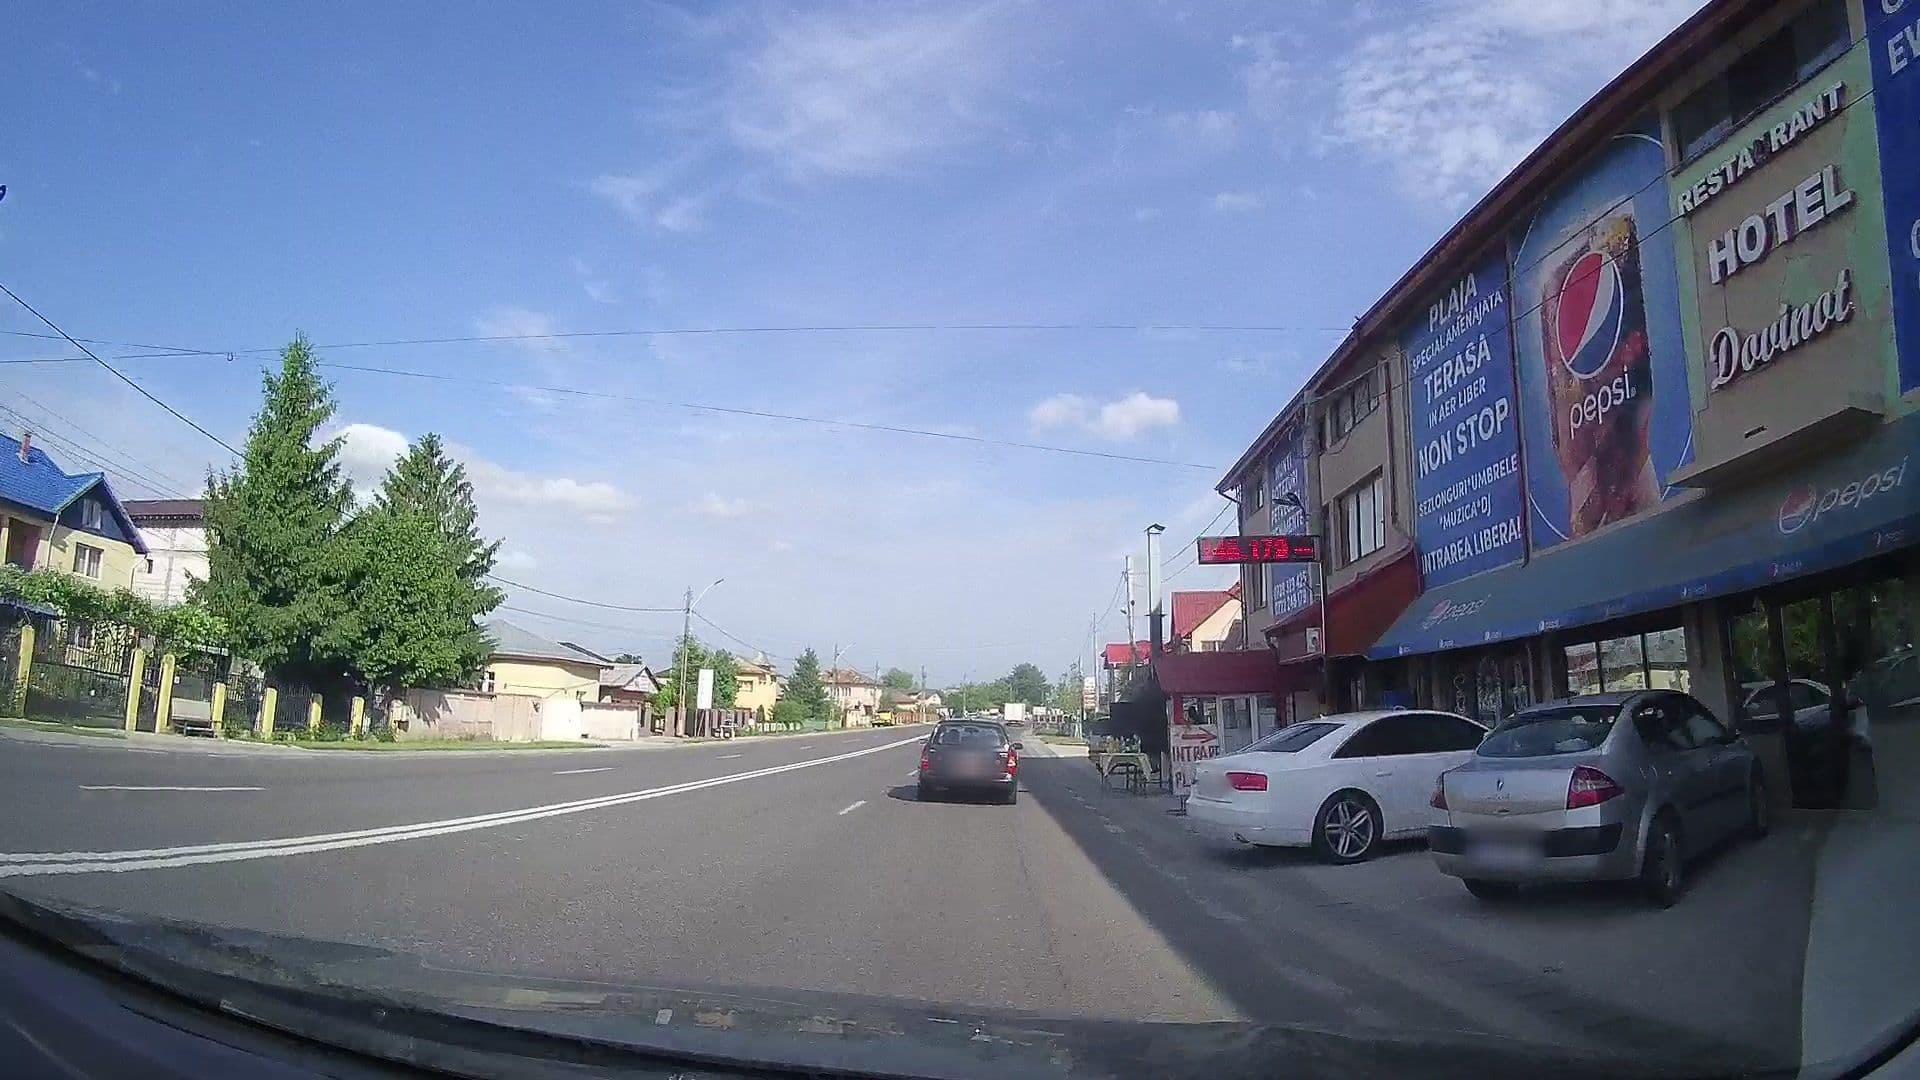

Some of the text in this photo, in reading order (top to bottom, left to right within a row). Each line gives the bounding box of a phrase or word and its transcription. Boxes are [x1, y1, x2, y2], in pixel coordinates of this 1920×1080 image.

[1709, 164, 1853, 285] HOTEL
[1429, 272, 1478, 333] PLAJA
[1458, 375, 1486, 409] LIBER
[1570, 364, 1630, 441] pepsi
[1418, 396, 1510, 480] NON STOP
[1813, 455, 1909, 522] pepsi
[1421, 516, 1522, 575] INTRAREA LIBERA!
